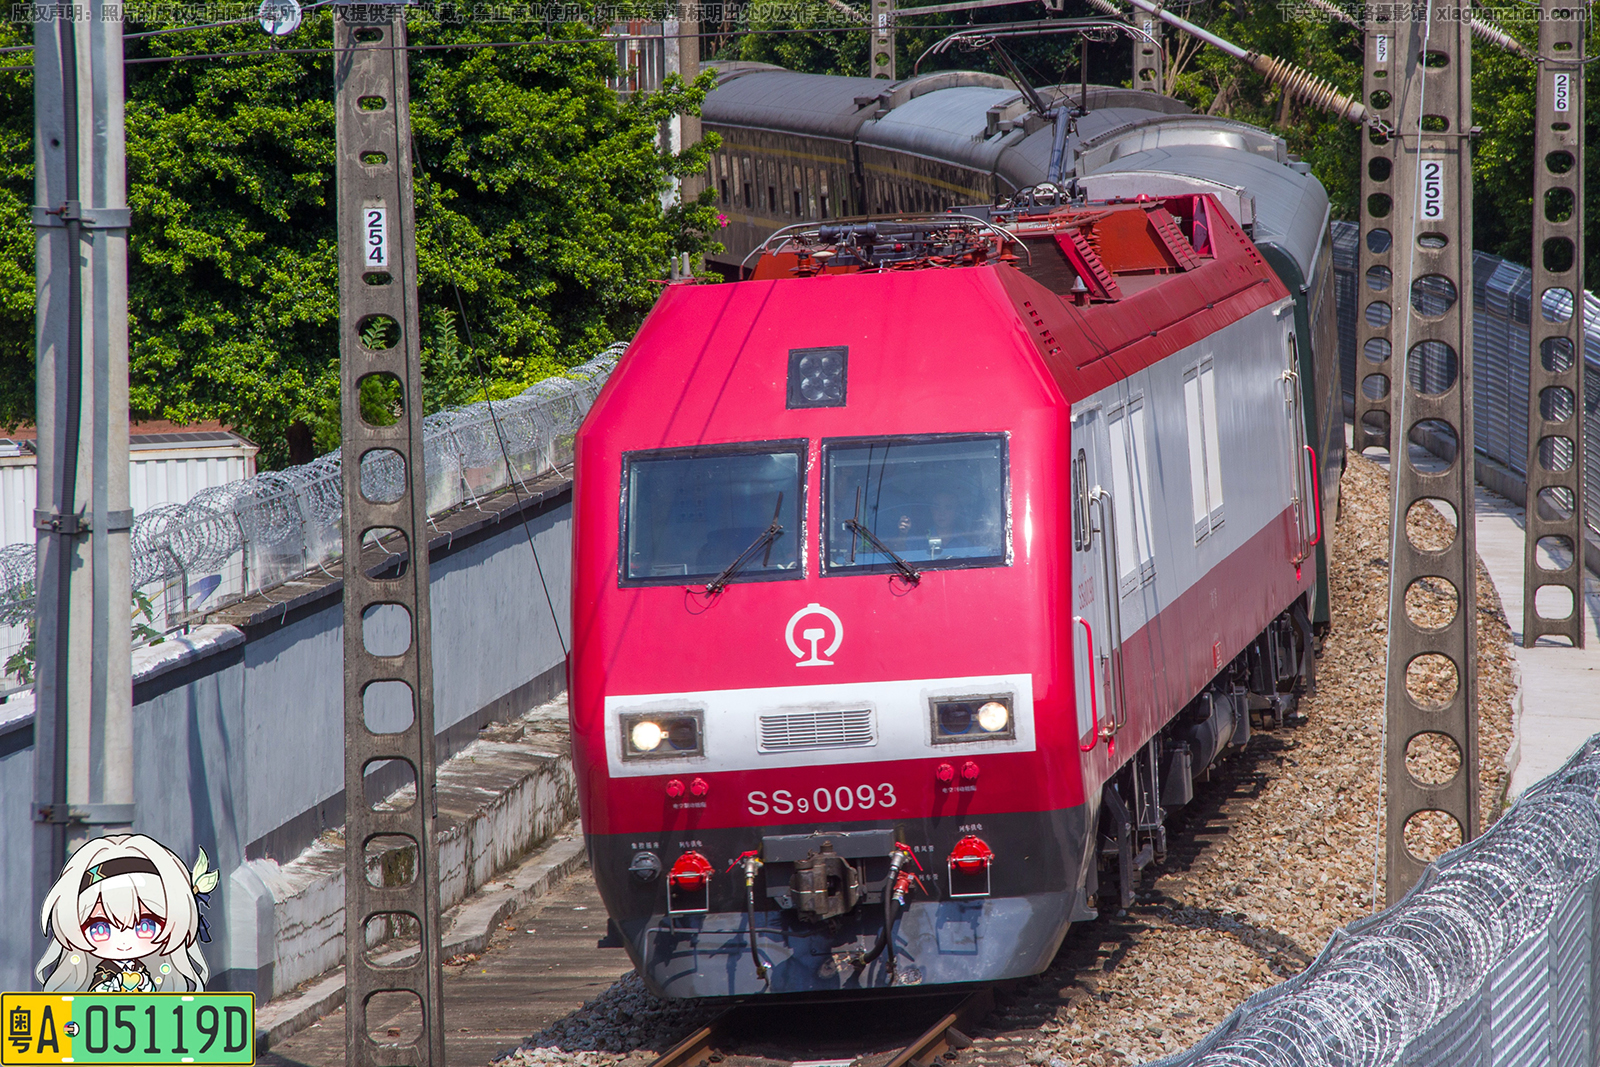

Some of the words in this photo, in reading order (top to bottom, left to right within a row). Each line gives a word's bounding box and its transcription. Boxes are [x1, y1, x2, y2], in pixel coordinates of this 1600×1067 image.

[1378, 35, 1386, 61] 257
[1556, 74, 1567, 109] 256
[1424, 162, 1440, 217] 255
[367, 210, 384, 263] 254
